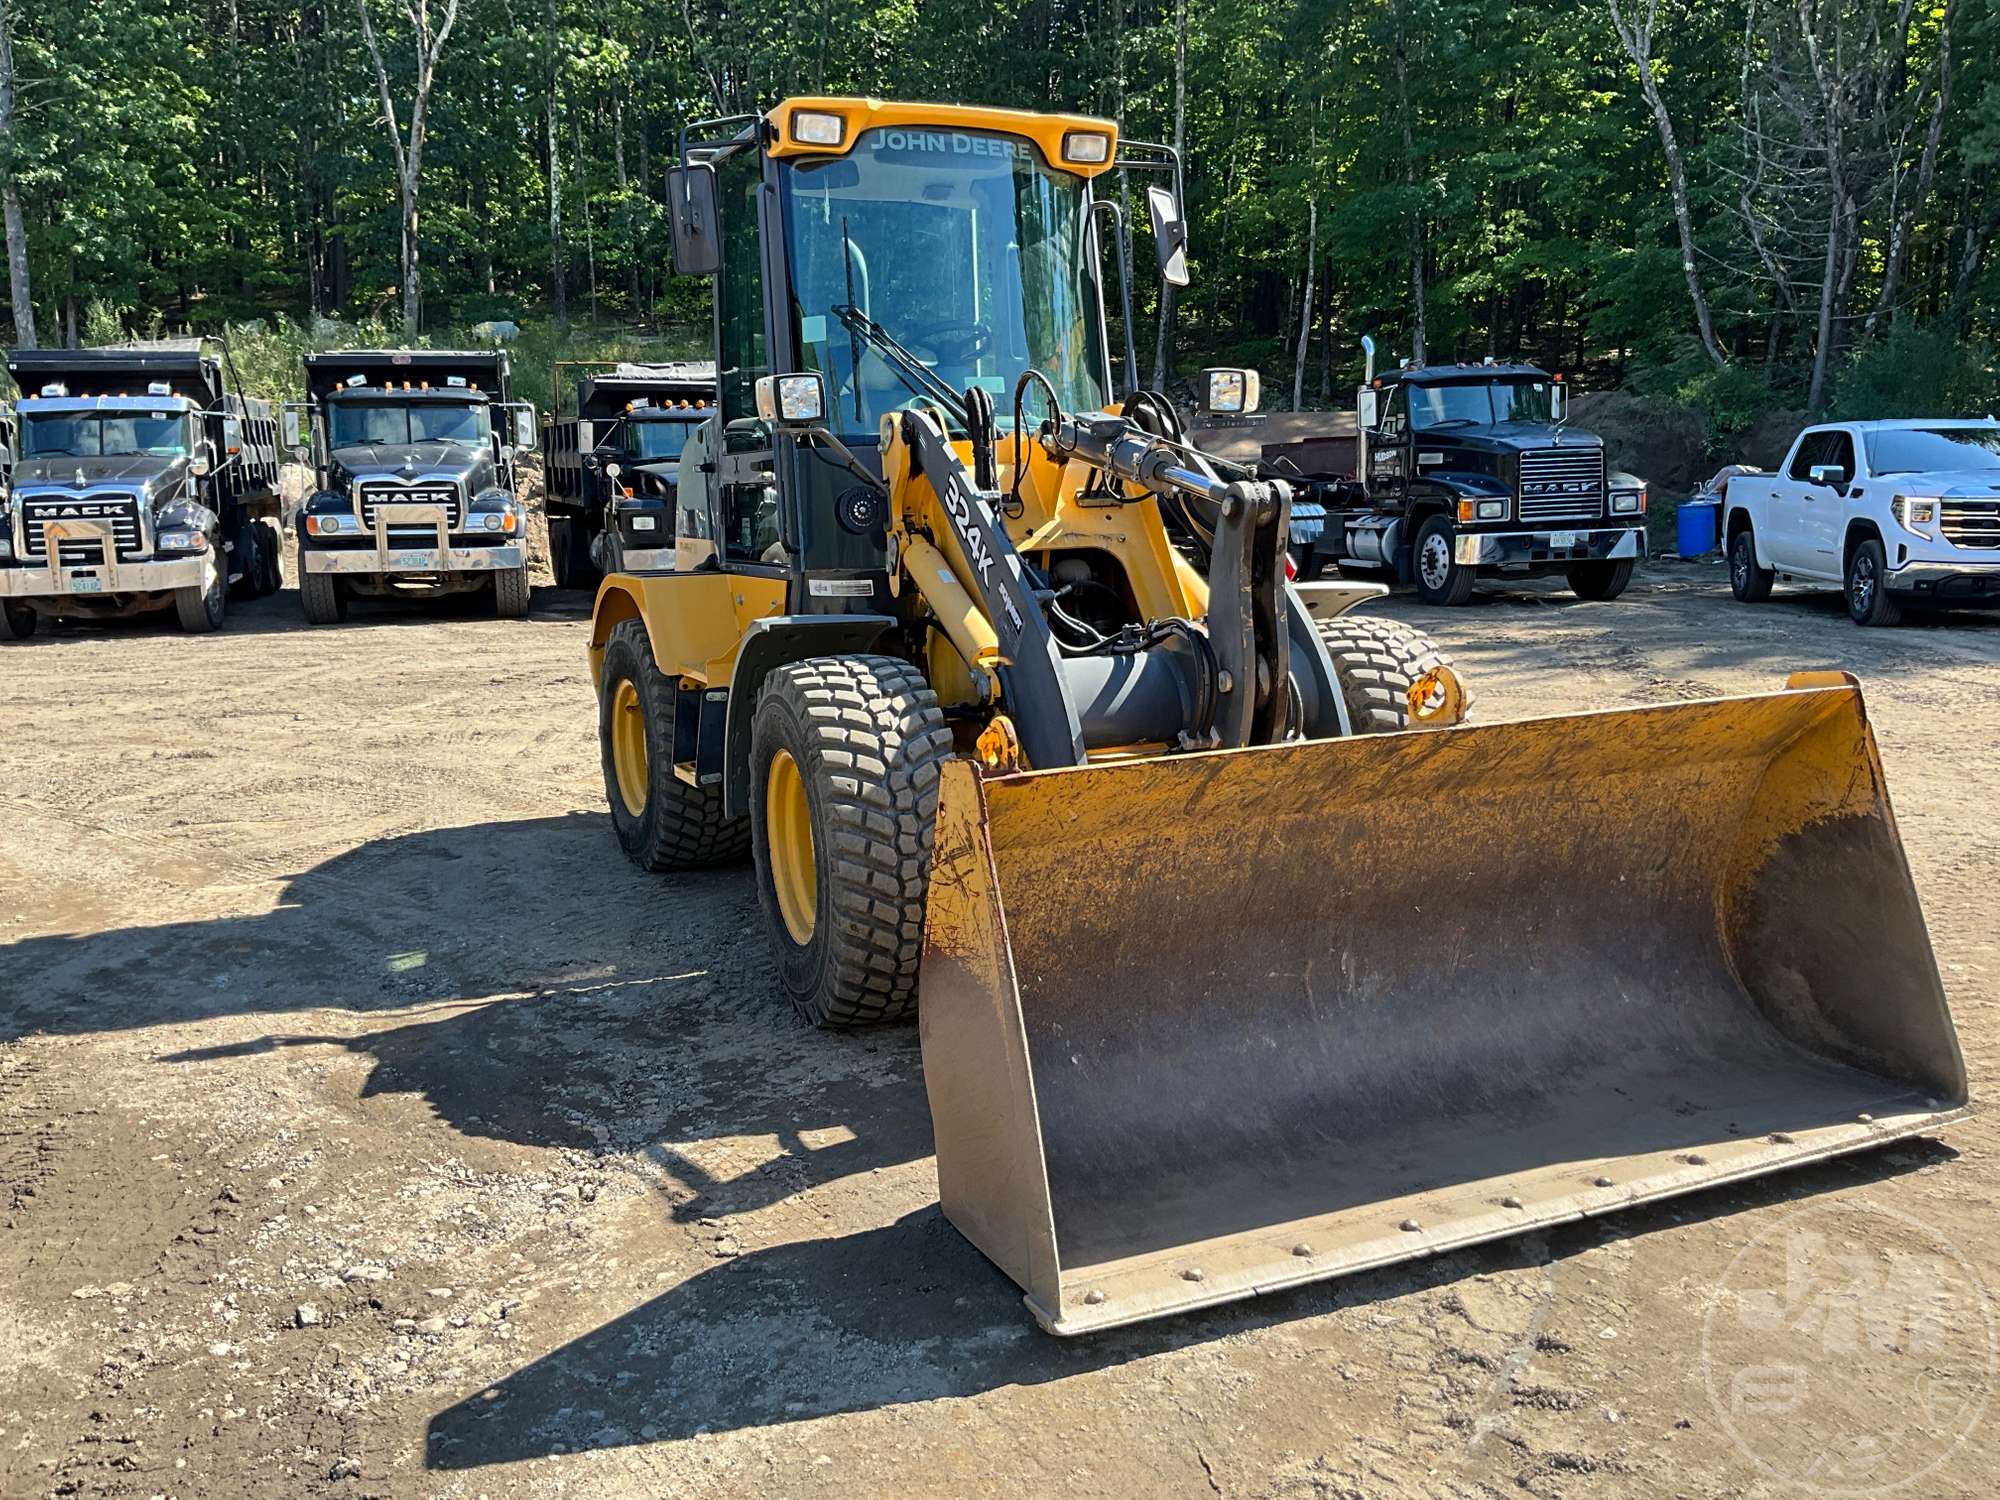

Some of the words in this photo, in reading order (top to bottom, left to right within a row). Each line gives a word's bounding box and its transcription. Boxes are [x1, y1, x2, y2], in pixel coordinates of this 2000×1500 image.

[871, 129, 946, 153] JOHN
[951, 133, 1032, 160] DEERE
[1374, 450, 1397, 462] HUDSON
[1523, 481, 1600, 494] MACK
[367, 492, 452, 502] MACK
[34, 505, 125, 517] MACK
[944, 473, 995, 588] 324K
